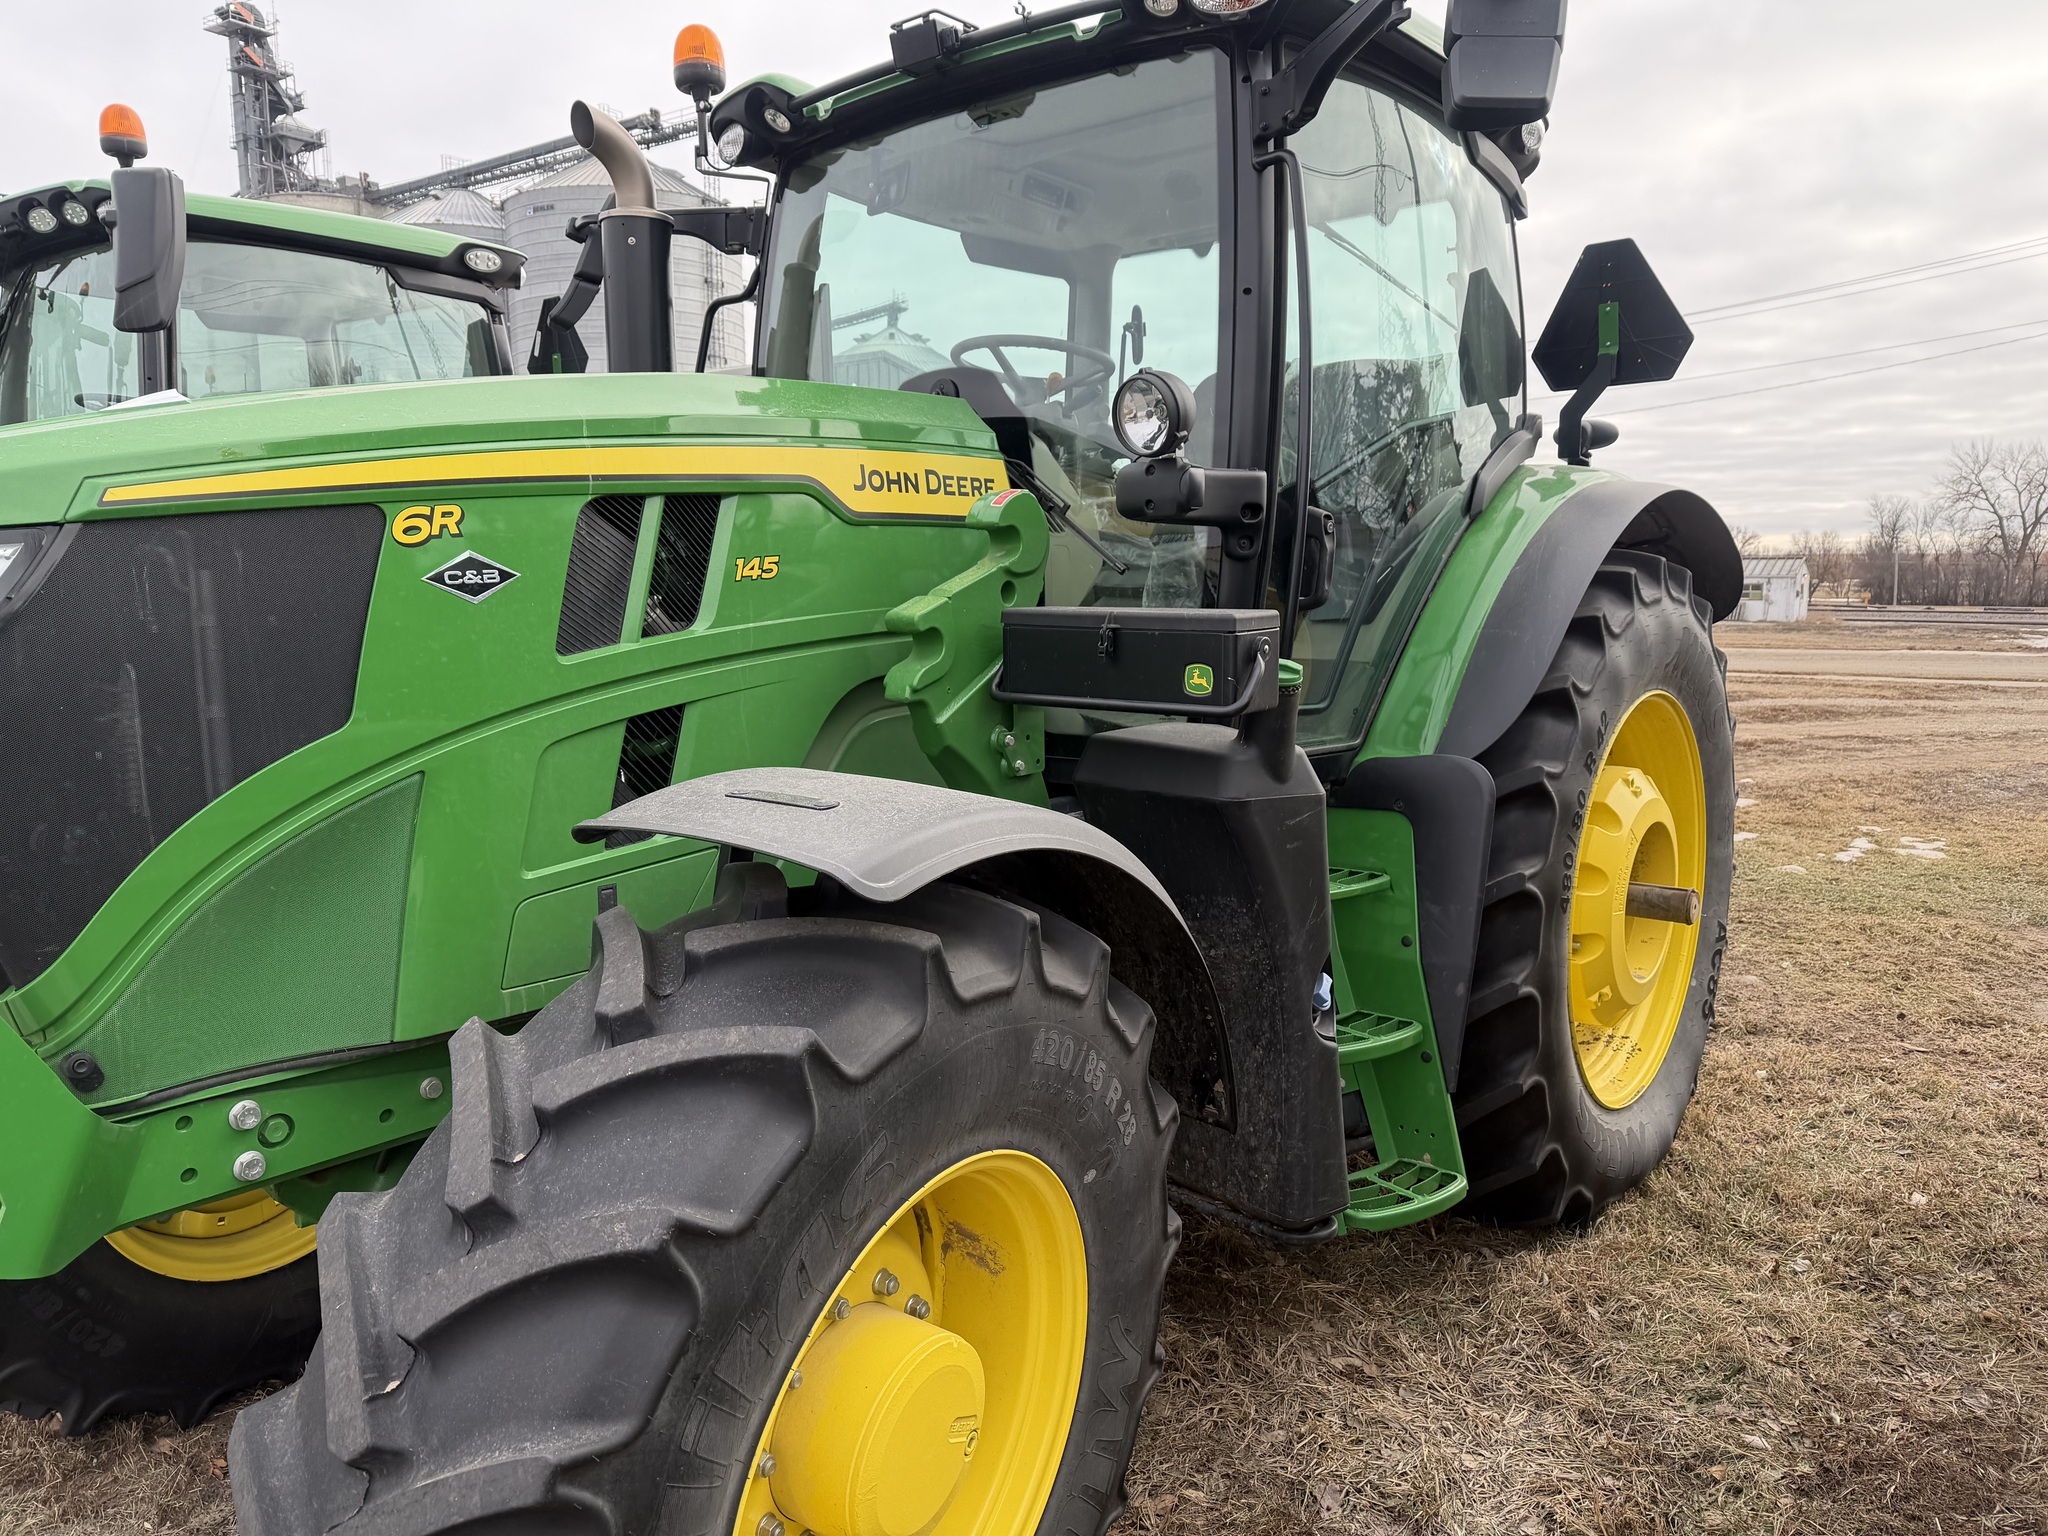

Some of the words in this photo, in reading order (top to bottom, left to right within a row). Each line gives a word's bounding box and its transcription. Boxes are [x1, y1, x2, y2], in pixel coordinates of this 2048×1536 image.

[854, 464, 920, 494] JOHN
[925, 469, 995, 498] DEERE
[391, 504, 465, 548] 6R
[444, 569, 500, 585] C&B
[735, 554, 780, 582] 145
[1583, 750, 1597, 778] R
[1597, 709, 1609, 750] 42
[1031, 1028, 1107, 1092] 420/85
[1104, 1077, 1122, 1115] R
[1116, 1100, 1137, 1146] 28
